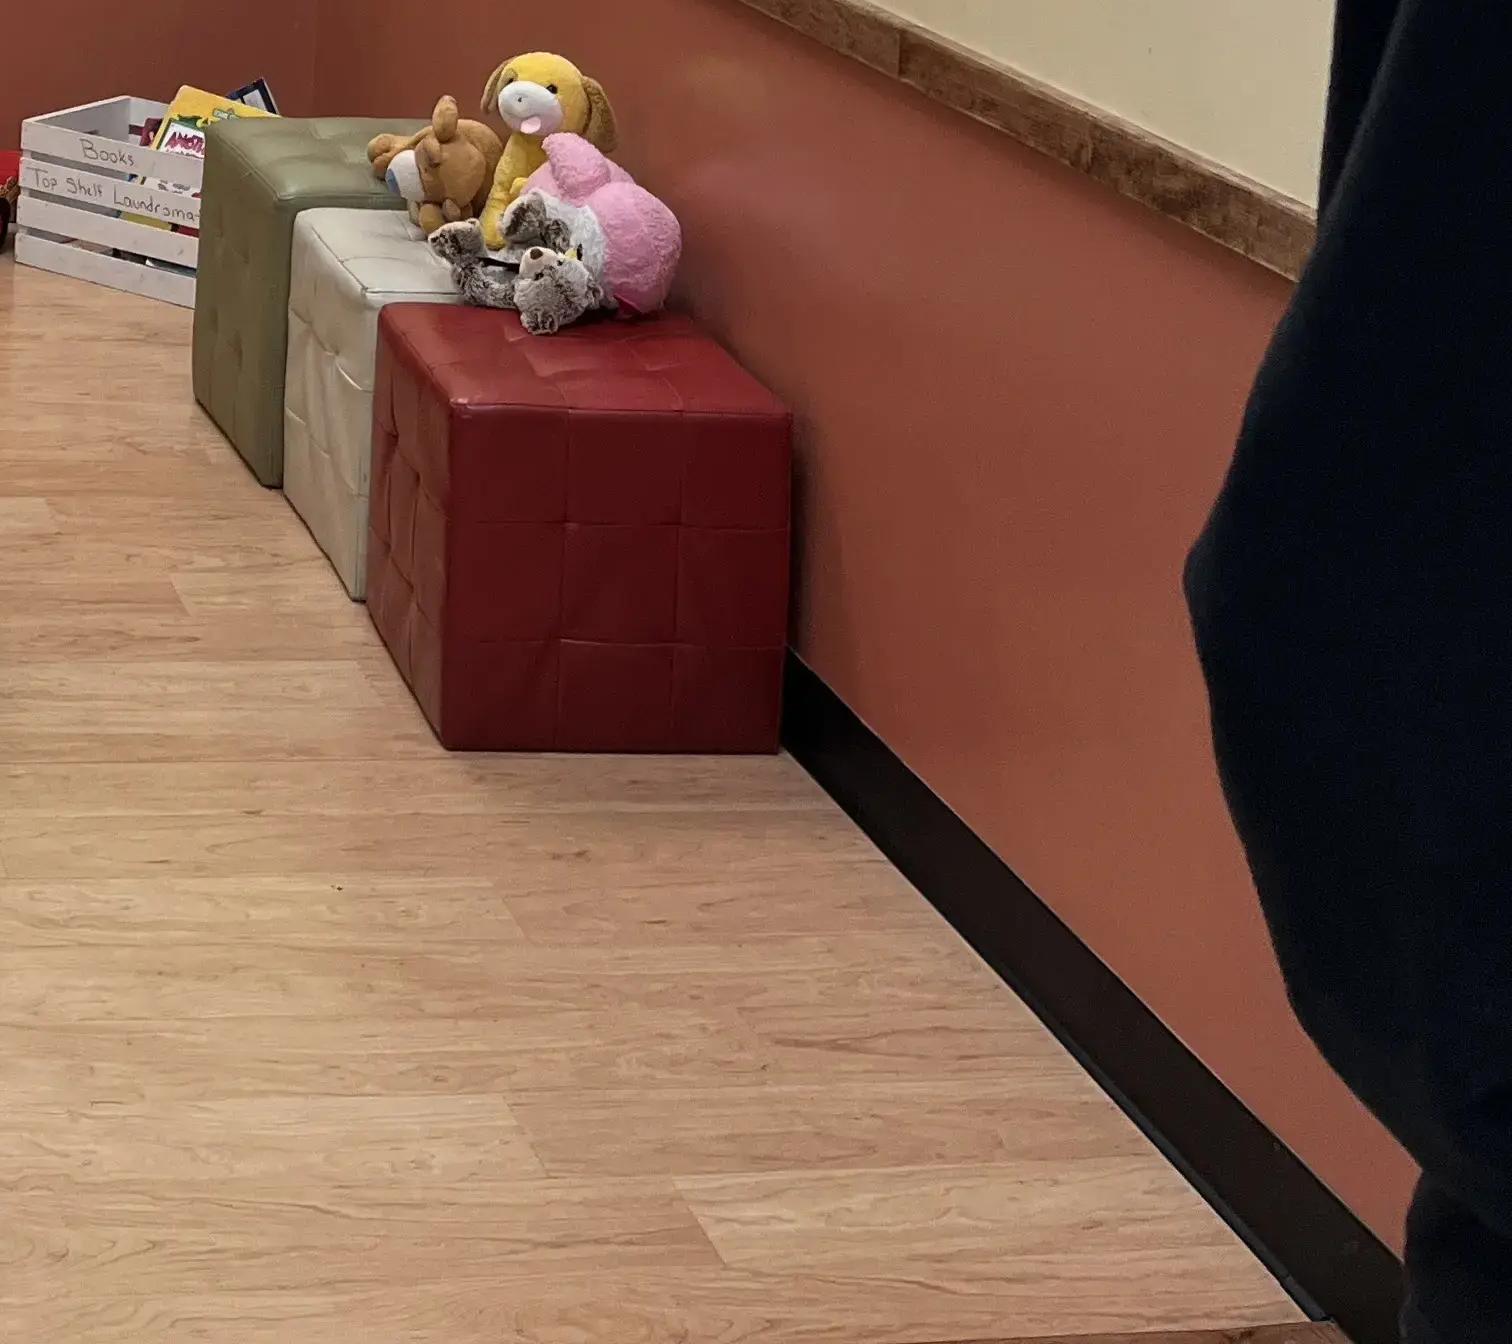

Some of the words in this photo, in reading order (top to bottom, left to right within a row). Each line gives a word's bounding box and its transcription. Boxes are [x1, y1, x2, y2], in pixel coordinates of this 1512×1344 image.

[79, 137, 134, 167] Books
[26, 167, 57, 191] Top
[65, 176, 103, 198] Shelf
